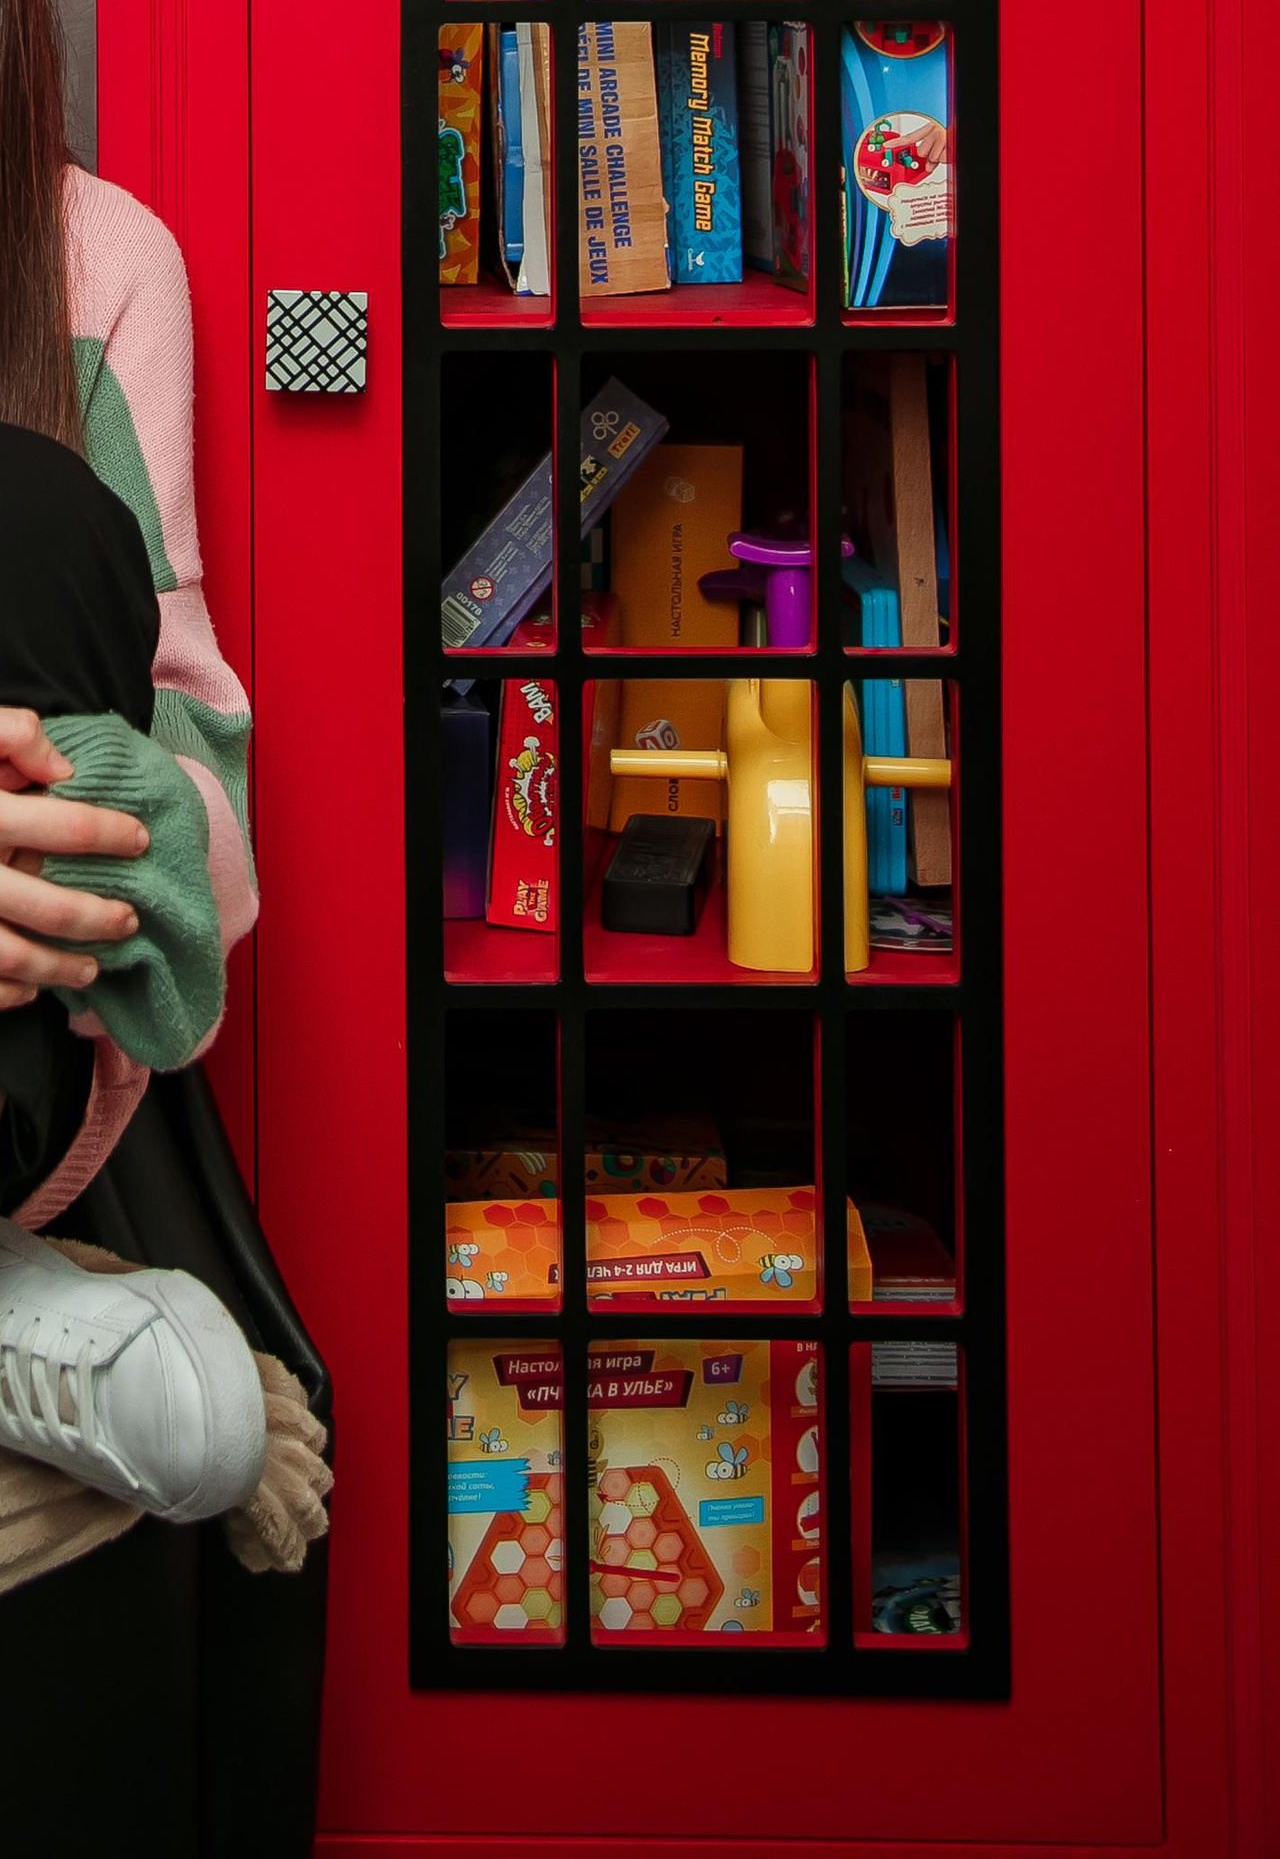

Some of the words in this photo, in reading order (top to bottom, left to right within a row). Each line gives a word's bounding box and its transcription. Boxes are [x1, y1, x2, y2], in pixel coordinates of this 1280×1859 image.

[595, 22, 615, 62] MINI
[687, 32, 711, 111] Memory
[578, 97, 596, 140] MINI
[598, 67, 623, 139] ARCADE
[692, 116, 715, 177] Match
[580, 144, 602, 202] SALLE
[605, 144, 633, 249] CHALLENGE
[694, 181, 716, 232] Game
[583, 206, 604, 231] DE
[587, 236, 610, 285] JEUX
[672, 523, 683, 552] ИГРА
[671, 555, 683, 638] НАСТОЛЬНАЯ
[520, 682, 553, 725] BAM
[513, 879, 531, 917] PLAY
[534, 879, 550, 923] GAME
[614, 1263, 633, 1276] 2-4
[636, 1260, 664, 1275] ДЛЯ
[665, 1260, 697, 1273] ИГРА
[606, 1355, 642, 1371] игра
[710, 1361, 731, 1376] 6+
[608, 1383, 618, 1397] В
[622, 1379, 674, 1397] УЛЬЕ»
